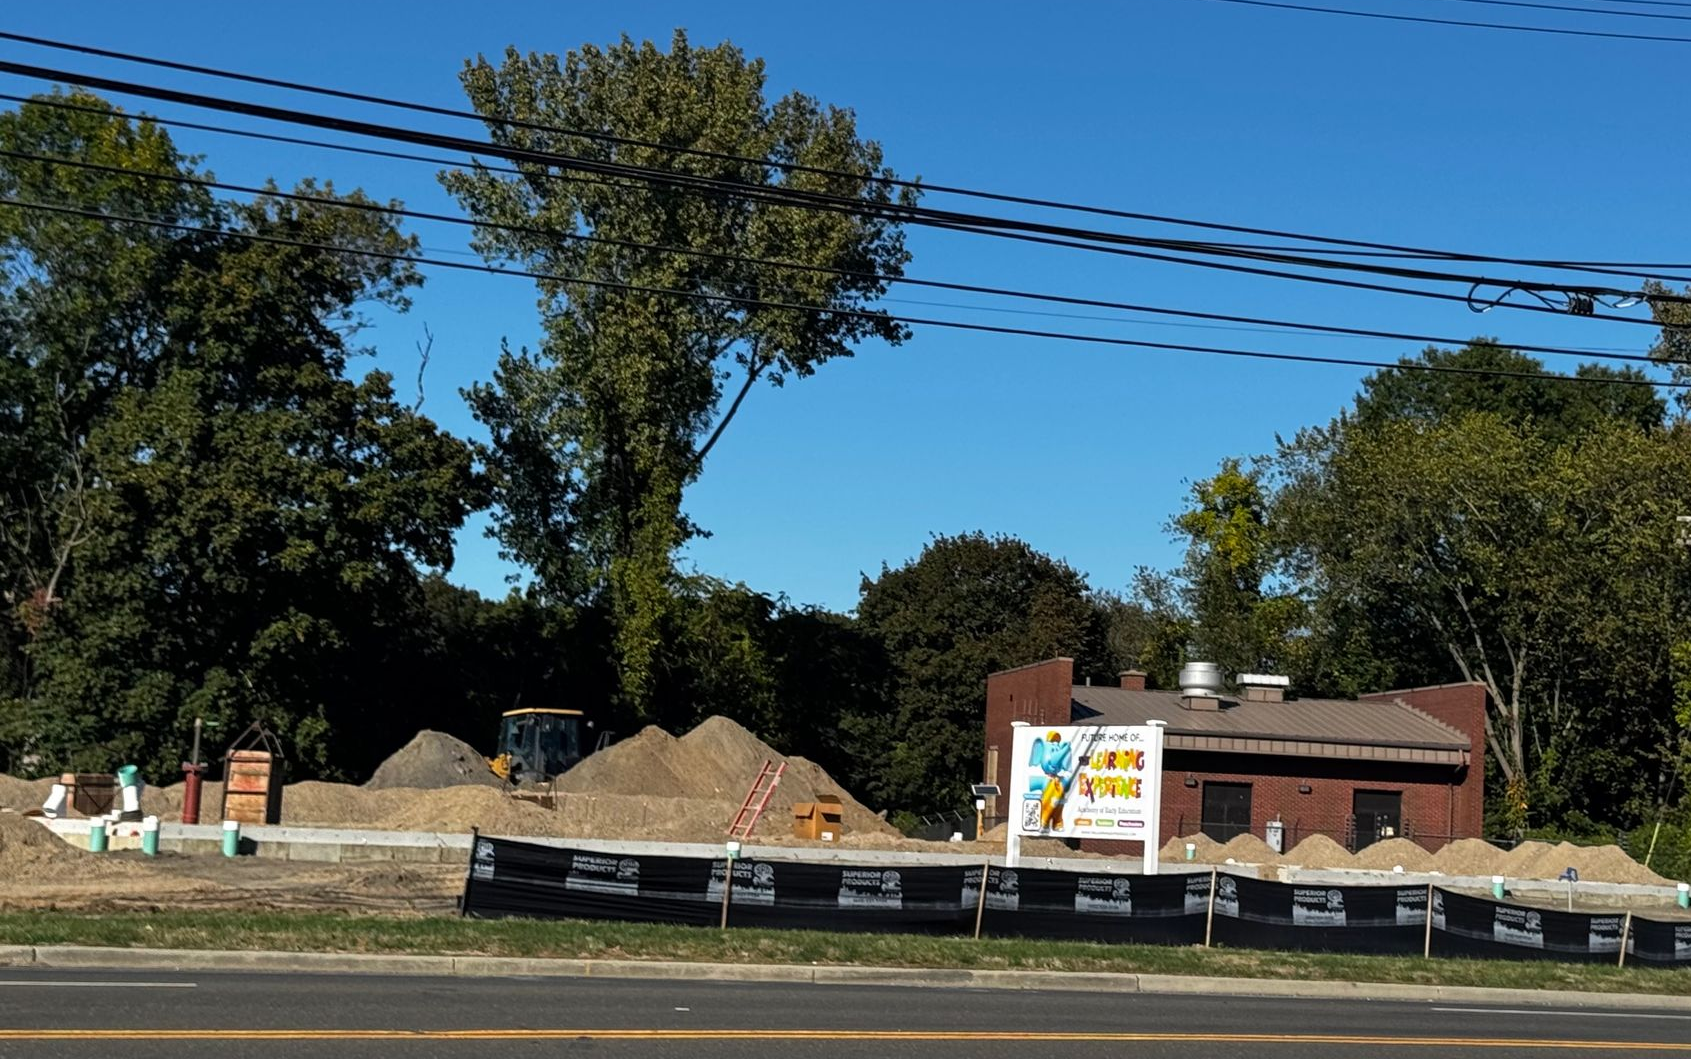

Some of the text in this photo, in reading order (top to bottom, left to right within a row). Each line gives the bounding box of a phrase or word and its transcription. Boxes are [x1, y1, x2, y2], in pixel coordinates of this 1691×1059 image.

[1081, 733, 1107, 742] FUTURE
[1109, 733, 1129, 742] HOME
[1090, 749, 1145, 772] LEARNING
[1078, 773, 1142, 803] EXPERIENCE
[572, 855, 619, 867] SUPERIOR
[711, 861, 753, 870] SUPRIOR
[572, 862, 617, 873] PRODUCTS
[711, 868, 752, 879] PROUCTS
[842, 870, 882, 879] SUPERIOR
[841, 878, 881, 887] PRODUCTS
[1078, 877, 1113, 885] SUPERIOR
[1293, 889, 1327, 897] SUPERIOR
